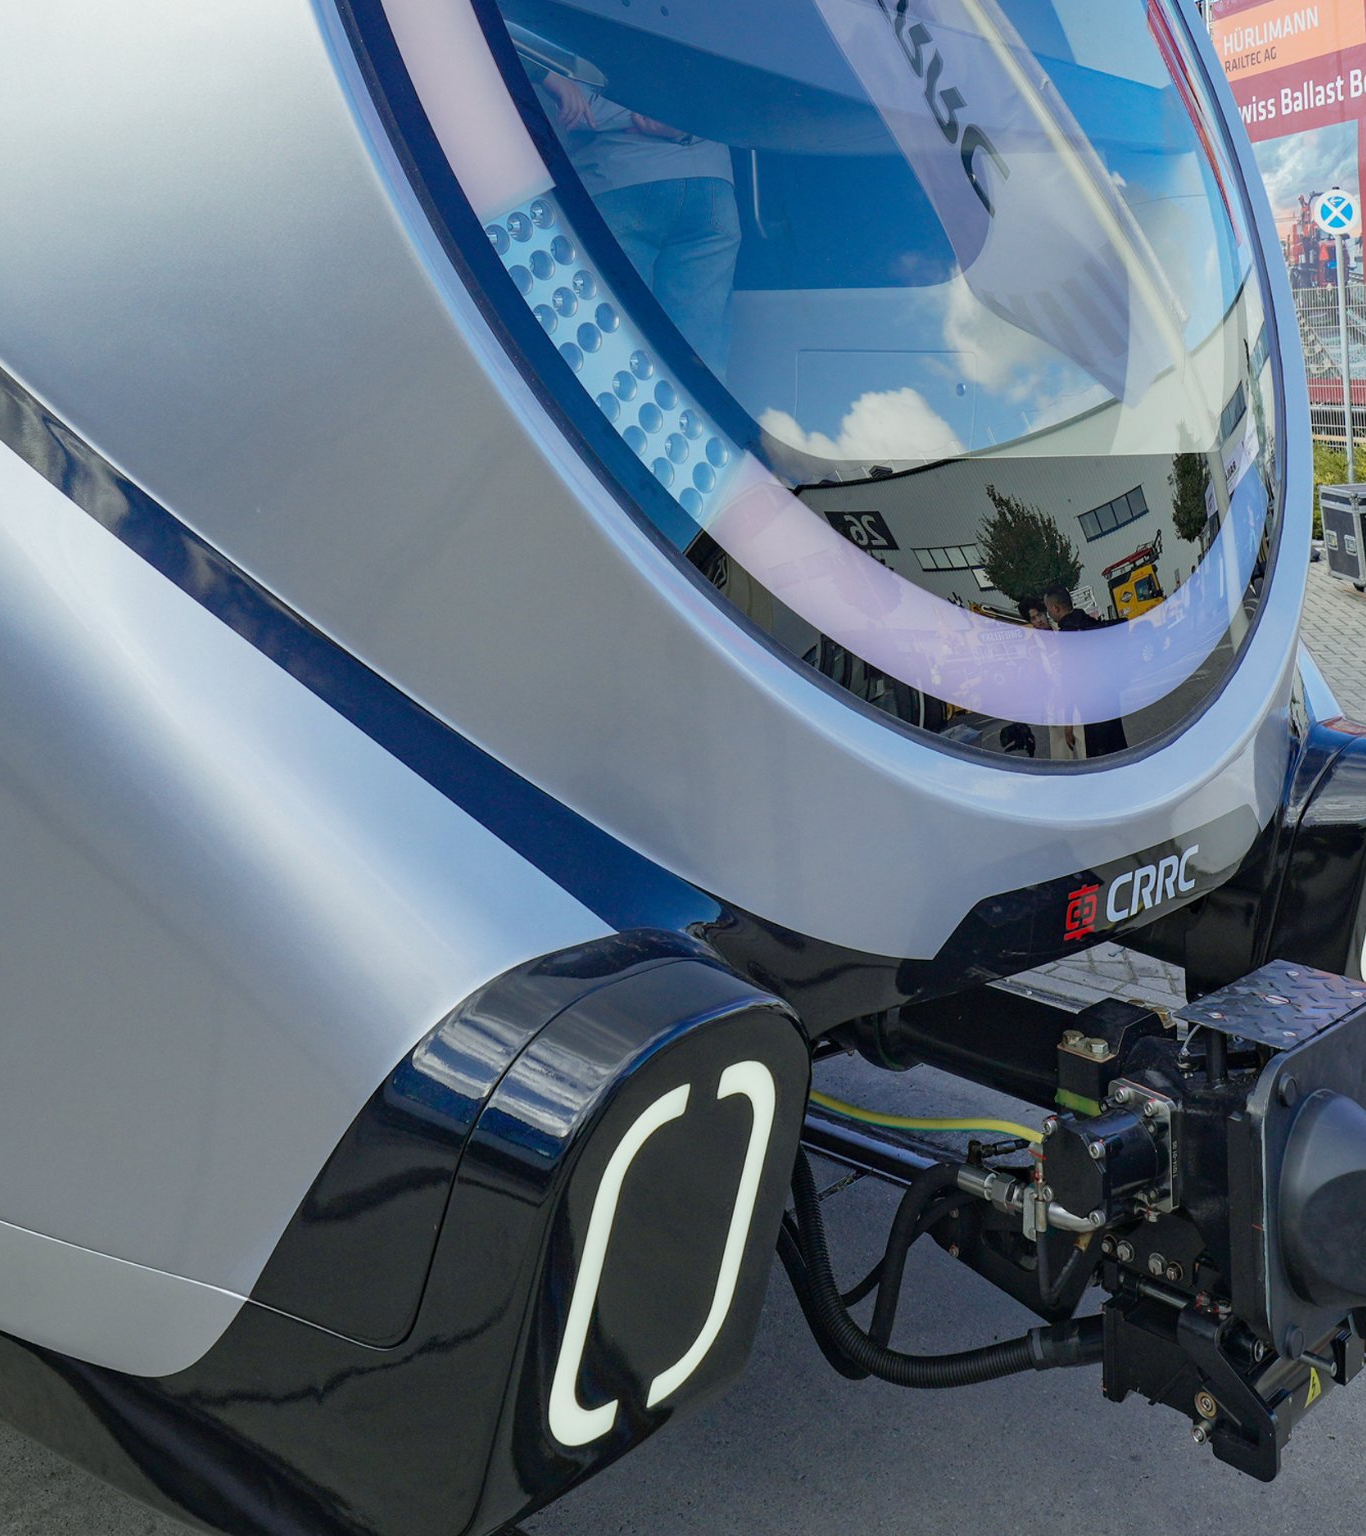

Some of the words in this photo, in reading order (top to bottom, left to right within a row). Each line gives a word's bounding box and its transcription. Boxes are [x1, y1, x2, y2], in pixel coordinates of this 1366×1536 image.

[1223, 5, 1320, 57] HÜRLIMANN
[1225, 50, 1262, 73] RAILTEC
[1264, 46, 1277, 62] AG
[1238, 95, 1276, 124] wiss
[1280, 75, 1345, 116] Ballast
[1106, 844, 1199, 923] CRRC
